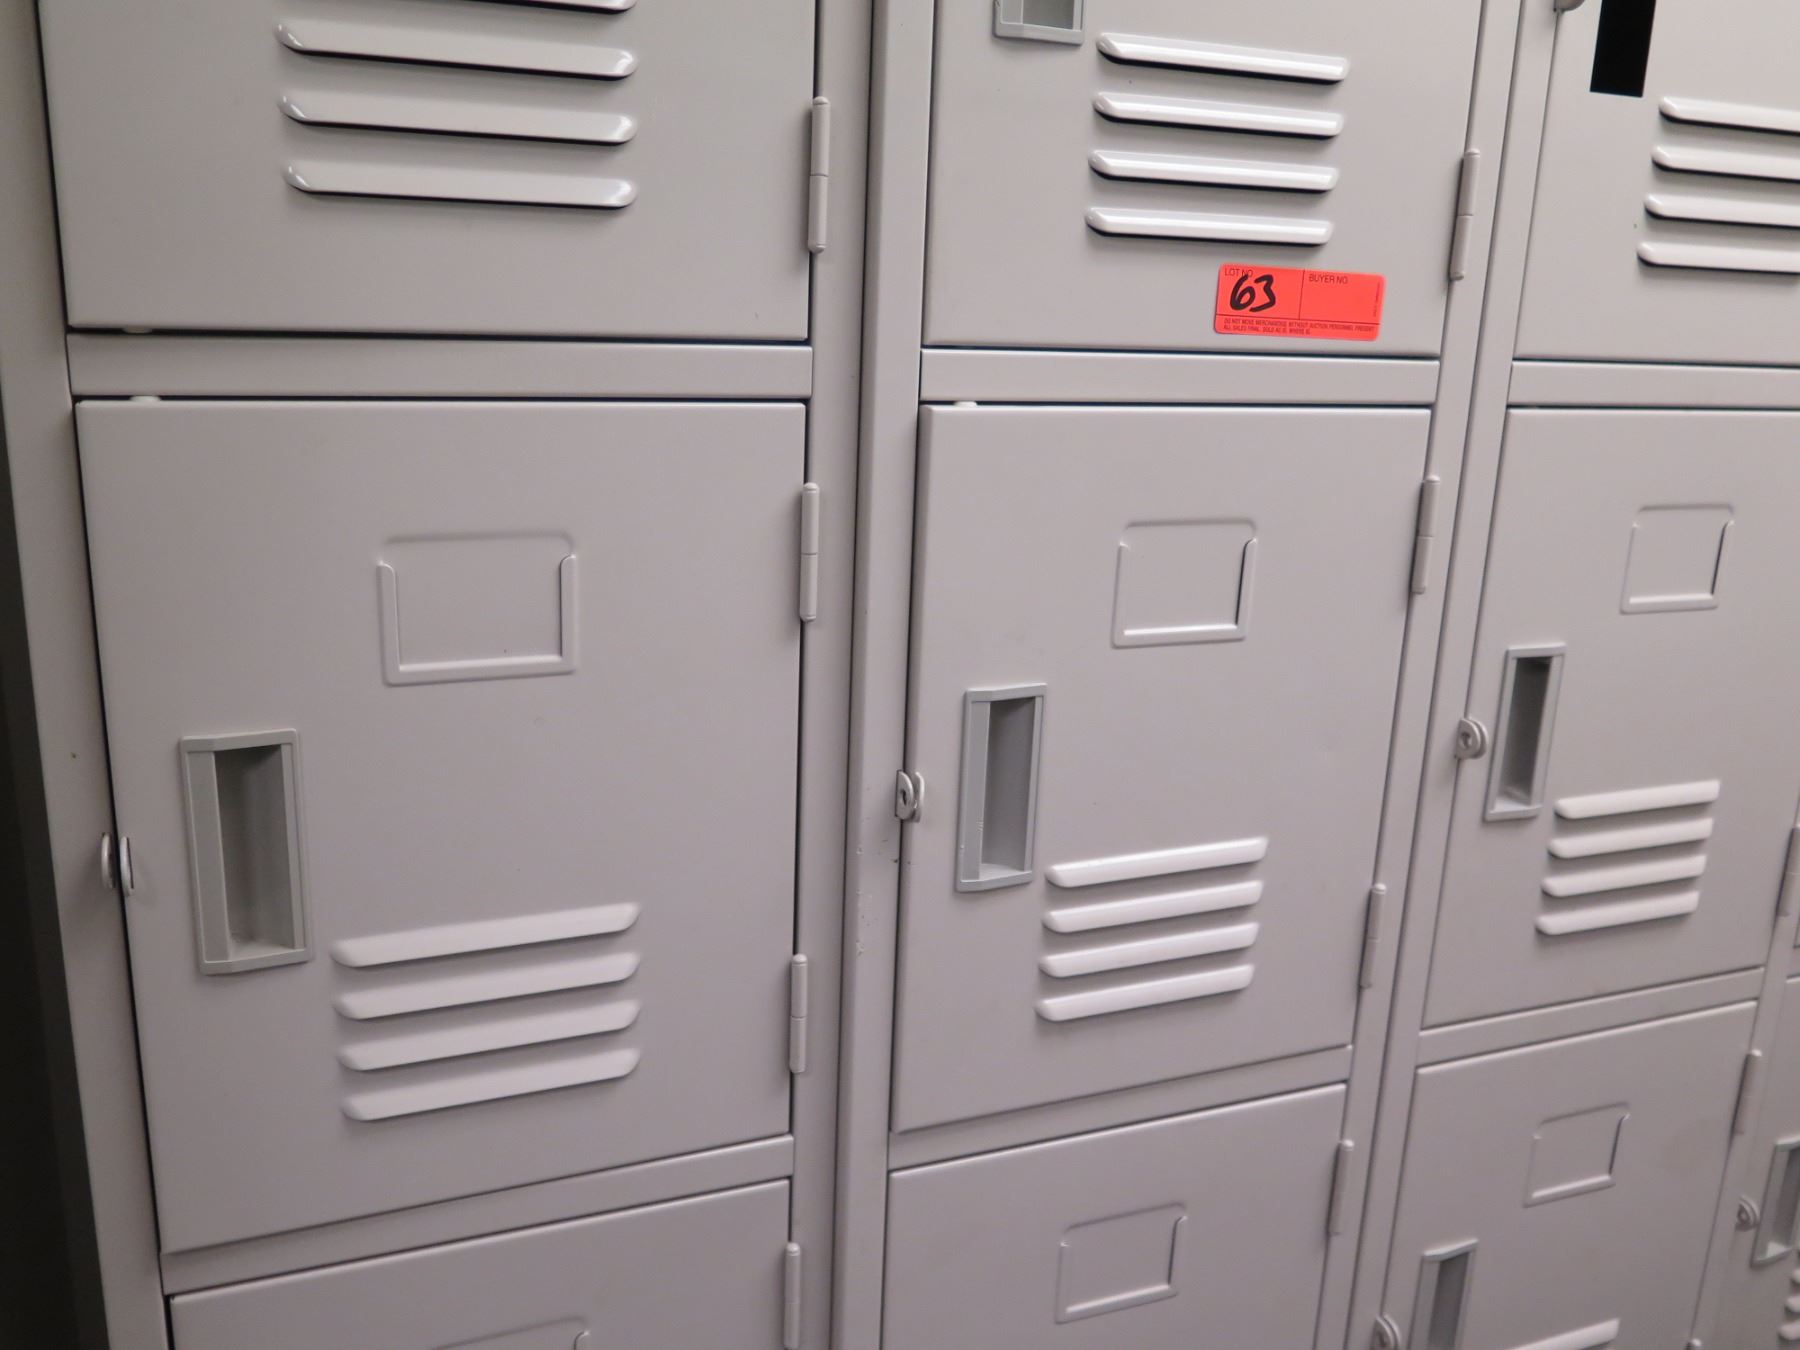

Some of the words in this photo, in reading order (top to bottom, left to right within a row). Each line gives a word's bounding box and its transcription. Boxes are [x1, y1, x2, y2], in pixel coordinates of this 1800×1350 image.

[1225, 268, 1240, 276] LOT
[1308, 273, 1334, 284] BUYER
[1230, 274, 1276, 312] 63
